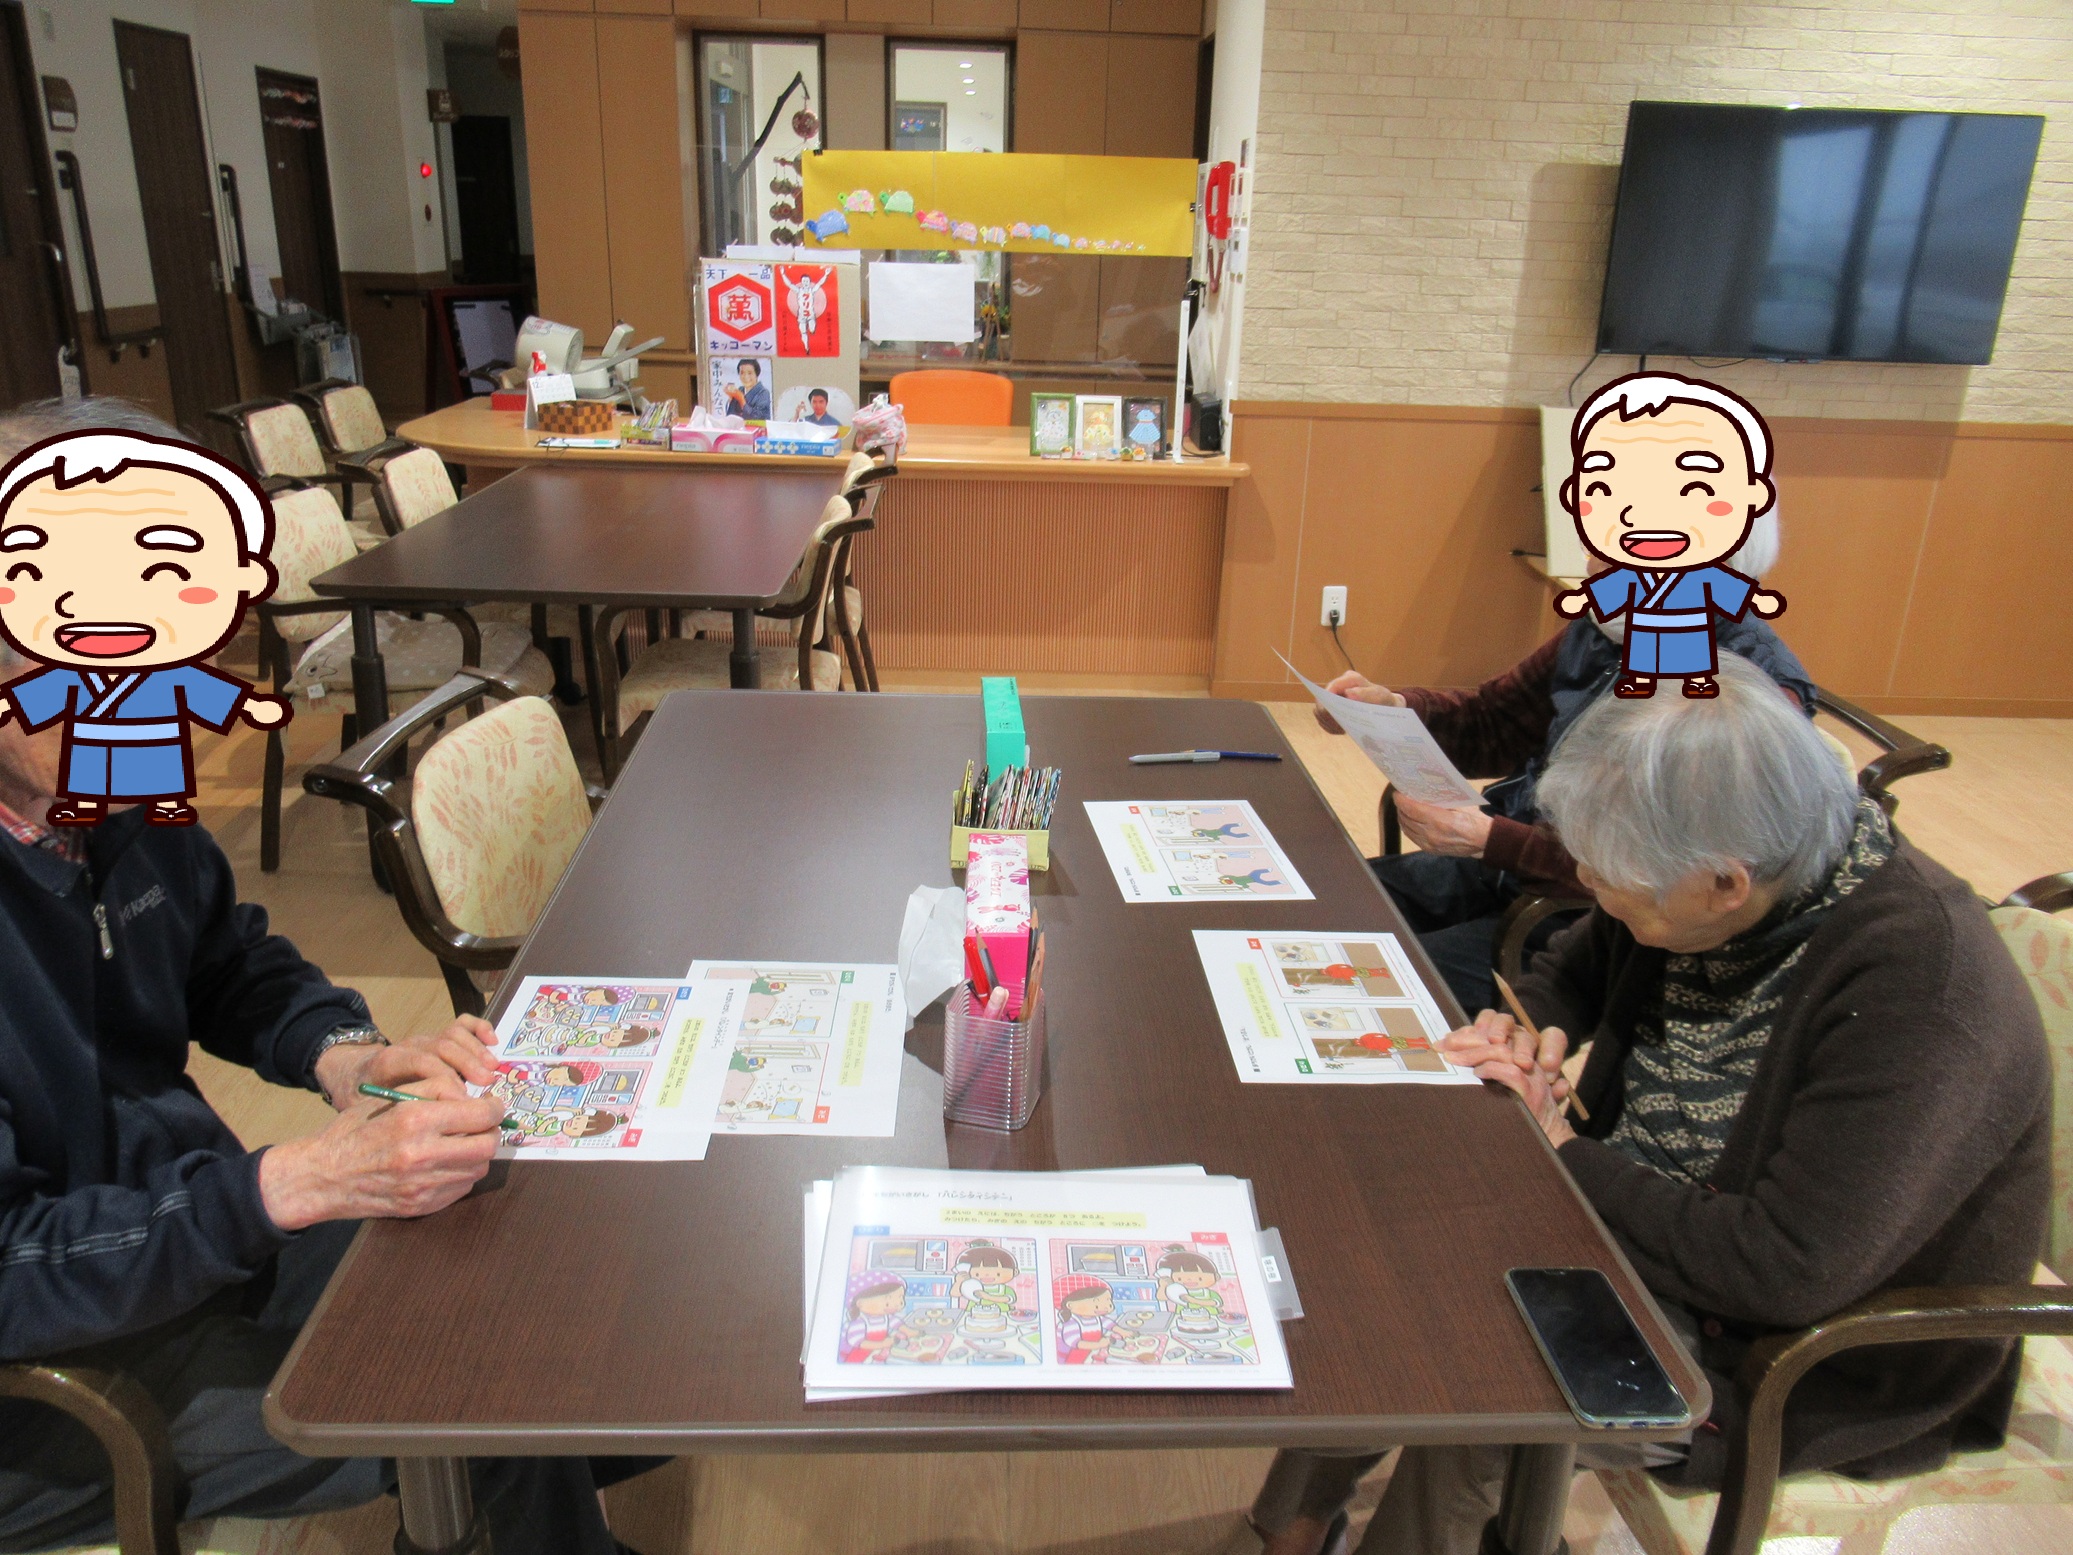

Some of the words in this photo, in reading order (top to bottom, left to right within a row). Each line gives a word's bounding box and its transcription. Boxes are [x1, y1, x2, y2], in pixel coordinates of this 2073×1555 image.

[706, 268, 727, 279] 天下
[748, 267, 771, 279] 一品
[710, 341, 773, 351] キッコーマン
